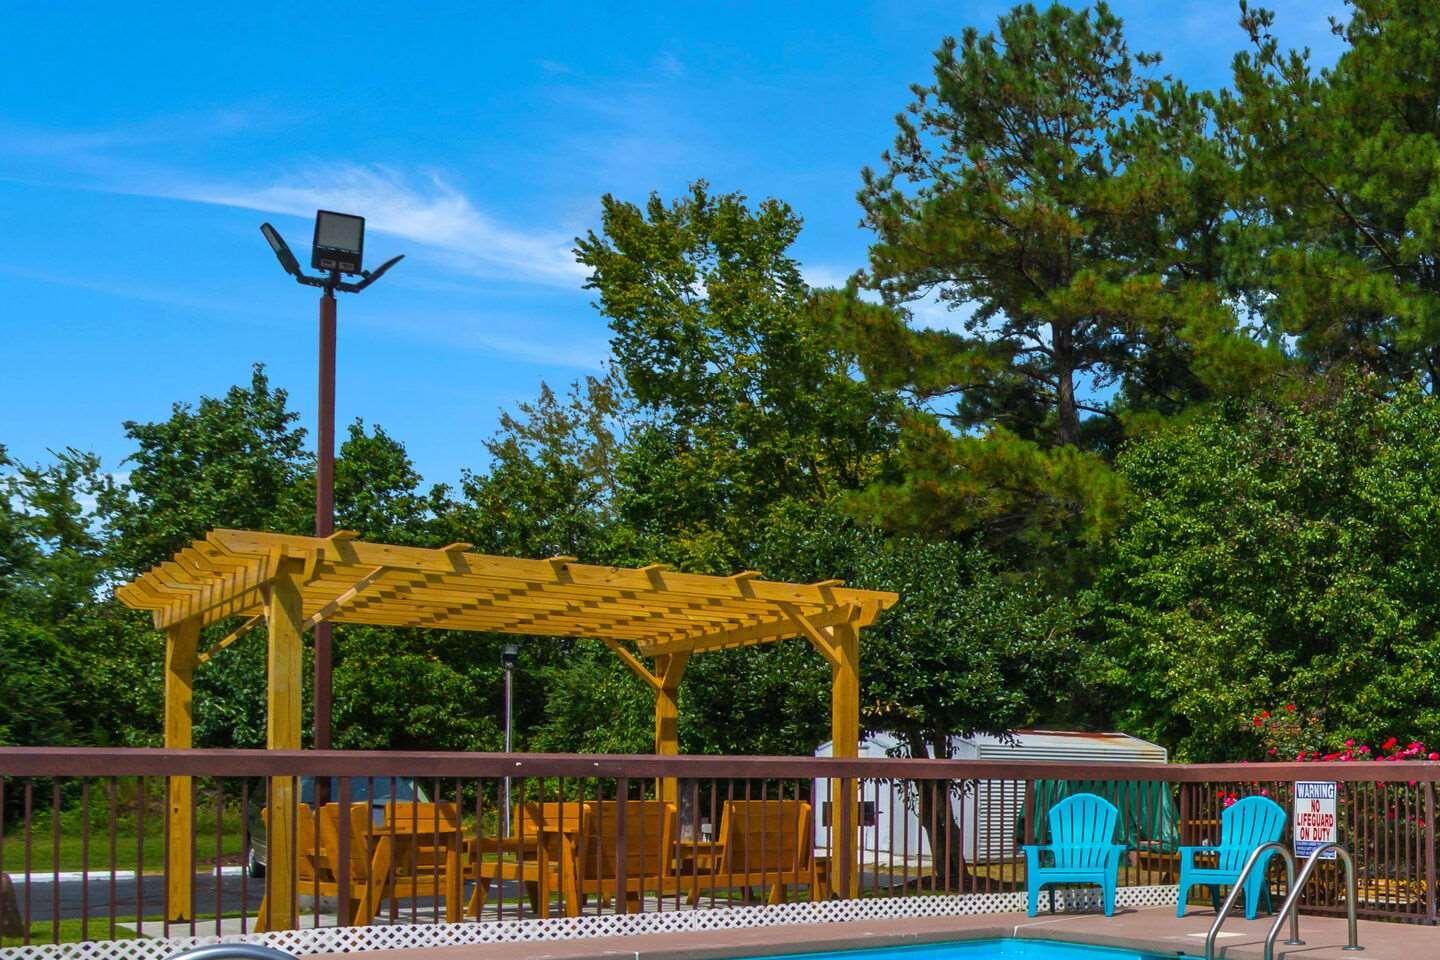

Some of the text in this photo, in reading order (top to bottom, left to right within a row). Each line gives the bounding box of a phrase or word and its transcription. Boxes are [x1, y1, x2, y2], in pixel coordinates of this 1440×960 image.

[1297, 784, 1334, 798] WARNING
[1311, 800, 1320, 813] NO
[1297, 813, 1333, 826] LIFEGUARD
[1300, 827, 1330, 841] ON DUTY
